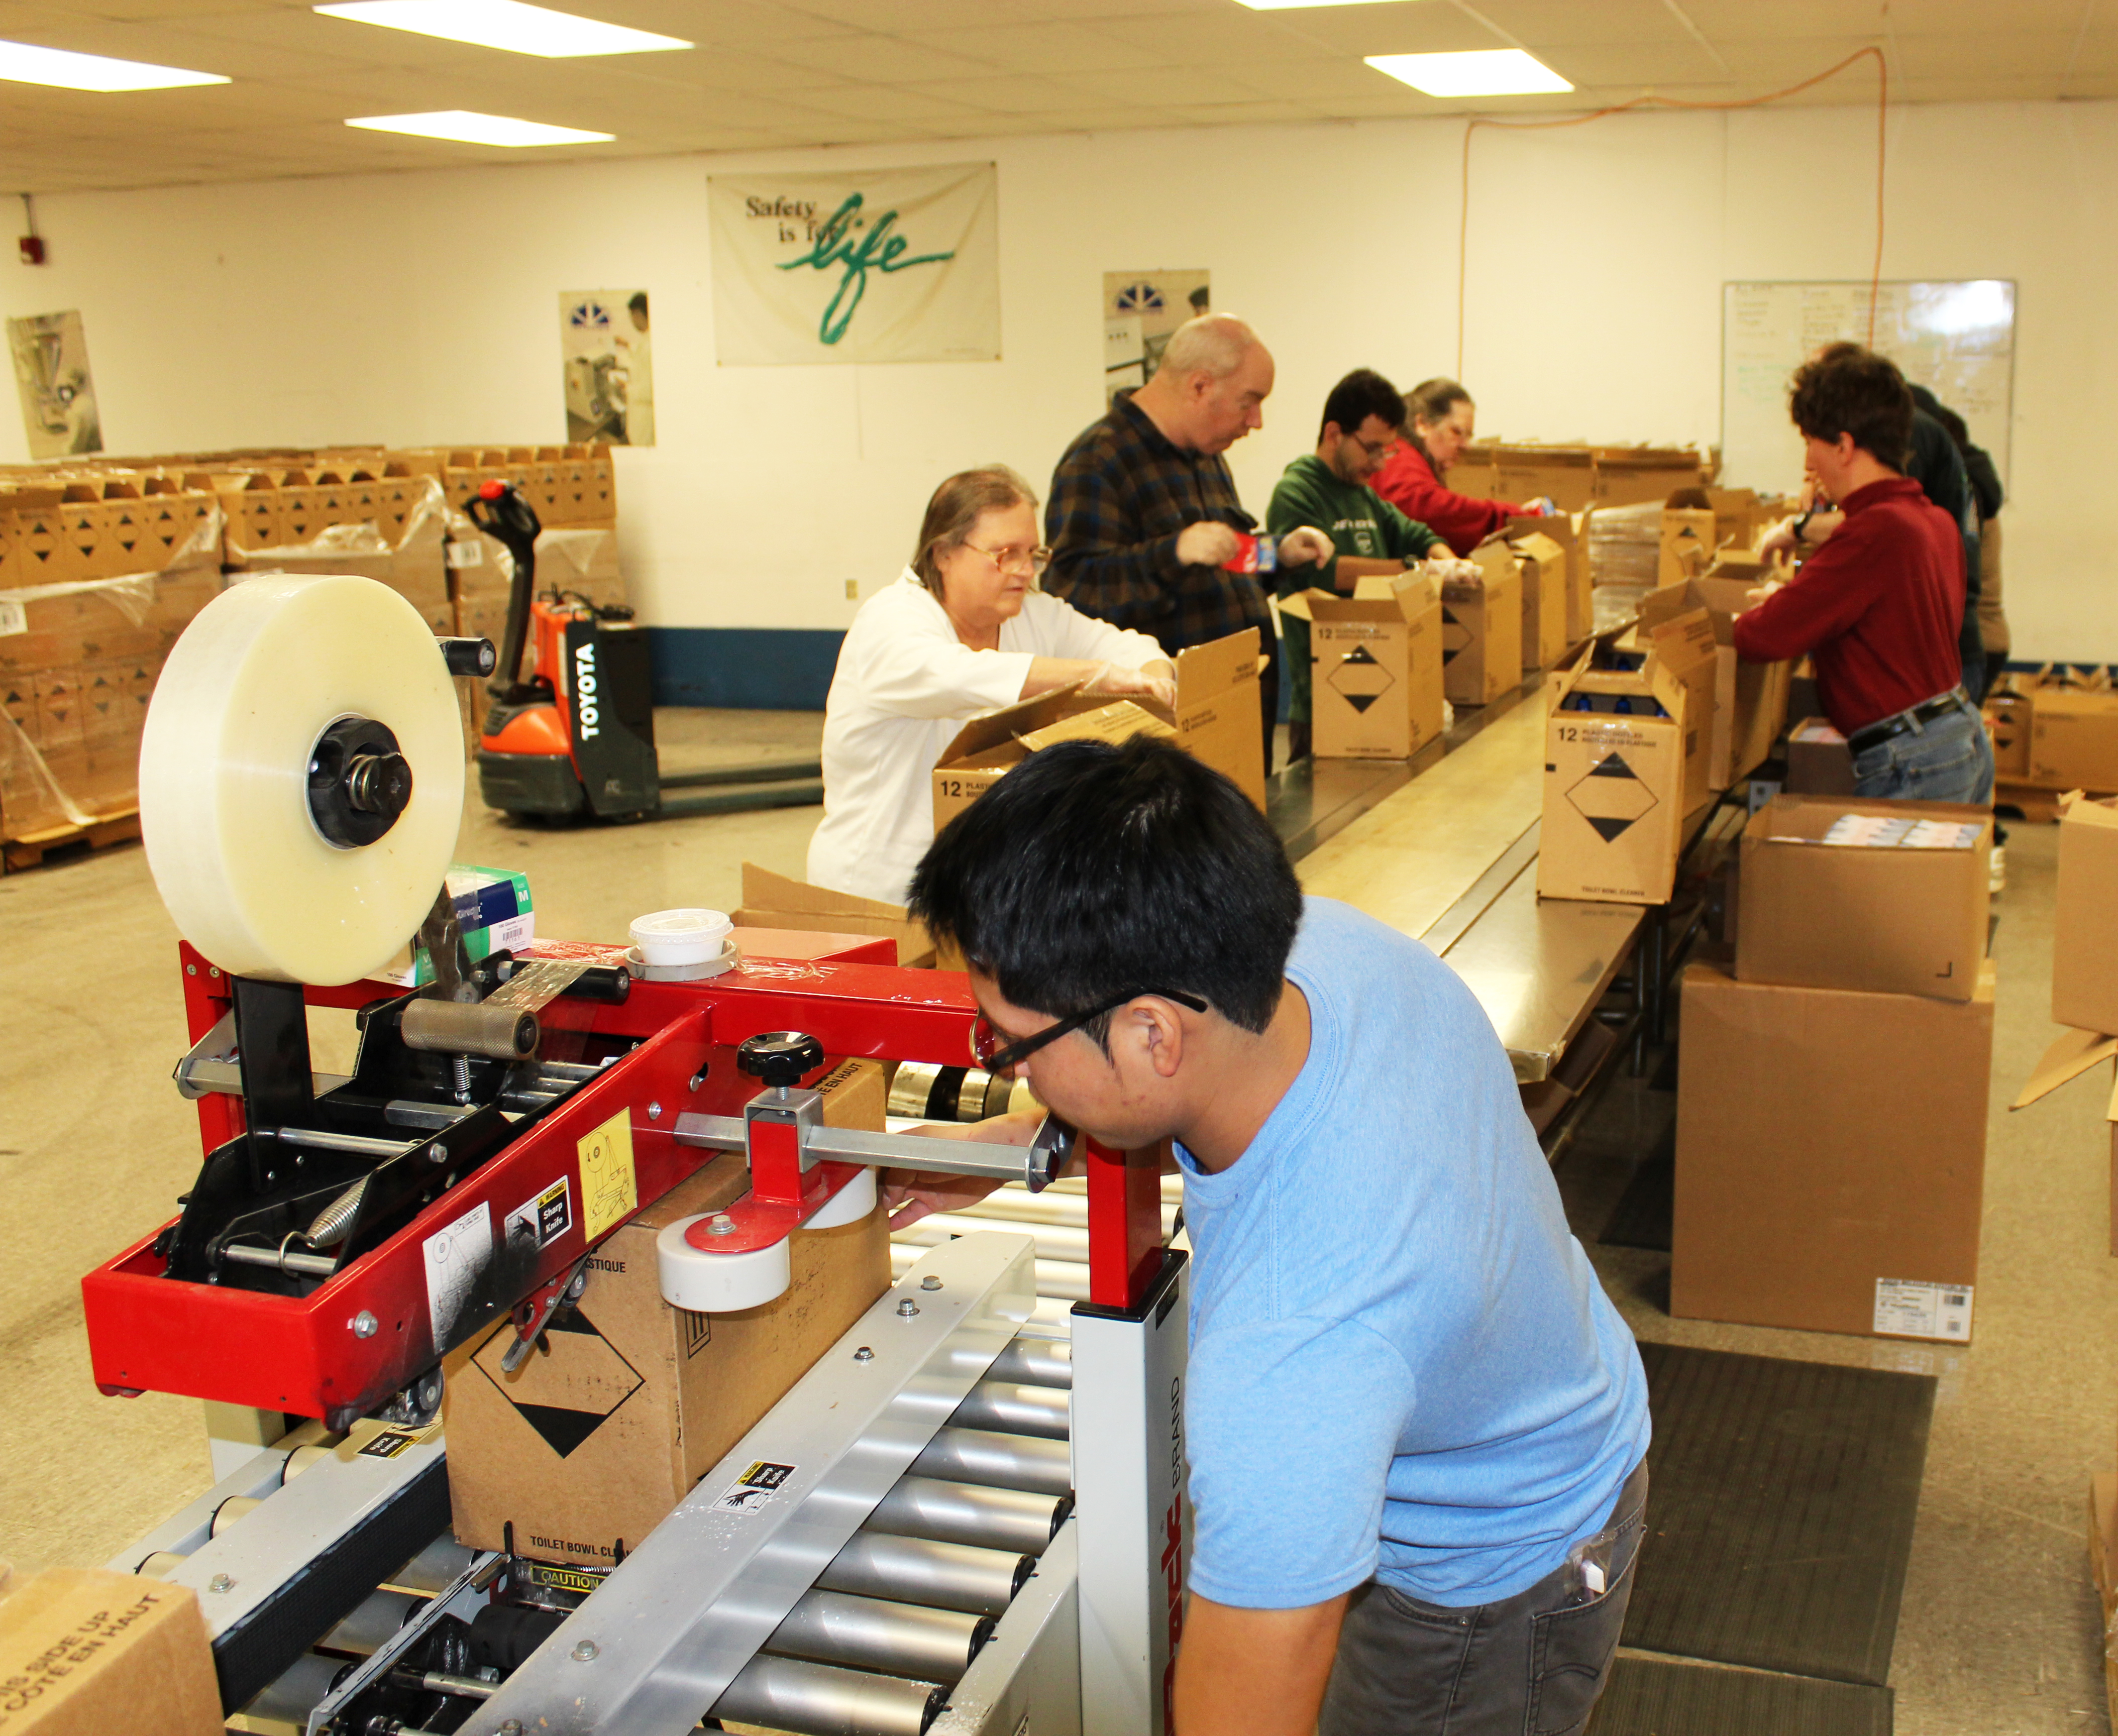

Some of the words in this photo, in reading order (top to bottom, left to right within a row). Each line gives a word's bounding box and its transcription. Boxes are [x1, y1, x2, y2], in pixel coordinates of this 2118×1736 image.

[746, 196, 815, 223] Safety
[779, 222, 795, 242] is
[806, 220, 837, 242] for
[775, 192, 955, 345] life
[575, 643, 600, 741] TOYOTA
[1558, 727, 1577, 741] 12
[940, 780, 961, 796] 12
[518, 890, 528, 902] M
[825, 1078, 843, 1088] EN
[836, 1063, 862, 1079] HAUT
[544, 1202, 563, 1220] Sharp
[546, 1217, 563, 1234] Knife
[587, 1258, 626, 1273] STIQUE
[1172, 1376, 1181, 1489] BRAND
[369, 1437, 391, 1451] Knife
[380, 1438, 402, 1453] Sharp
[754, 1467, 773, 1483] Sharp
[767, 1470, 785, 1484] Knife
[530, 1536, 564, 1550] TOILET
[567, 1542, 598, 1555] BOWL
[541, 1570, 599, 1588] CAUTION
[67, 1640, 106, 1663] EN
[99, 1593, 160, 1637] HAUT
[26, 1636, 84, 1672] SIDE
[77, 1610, 109, 1632] UP
